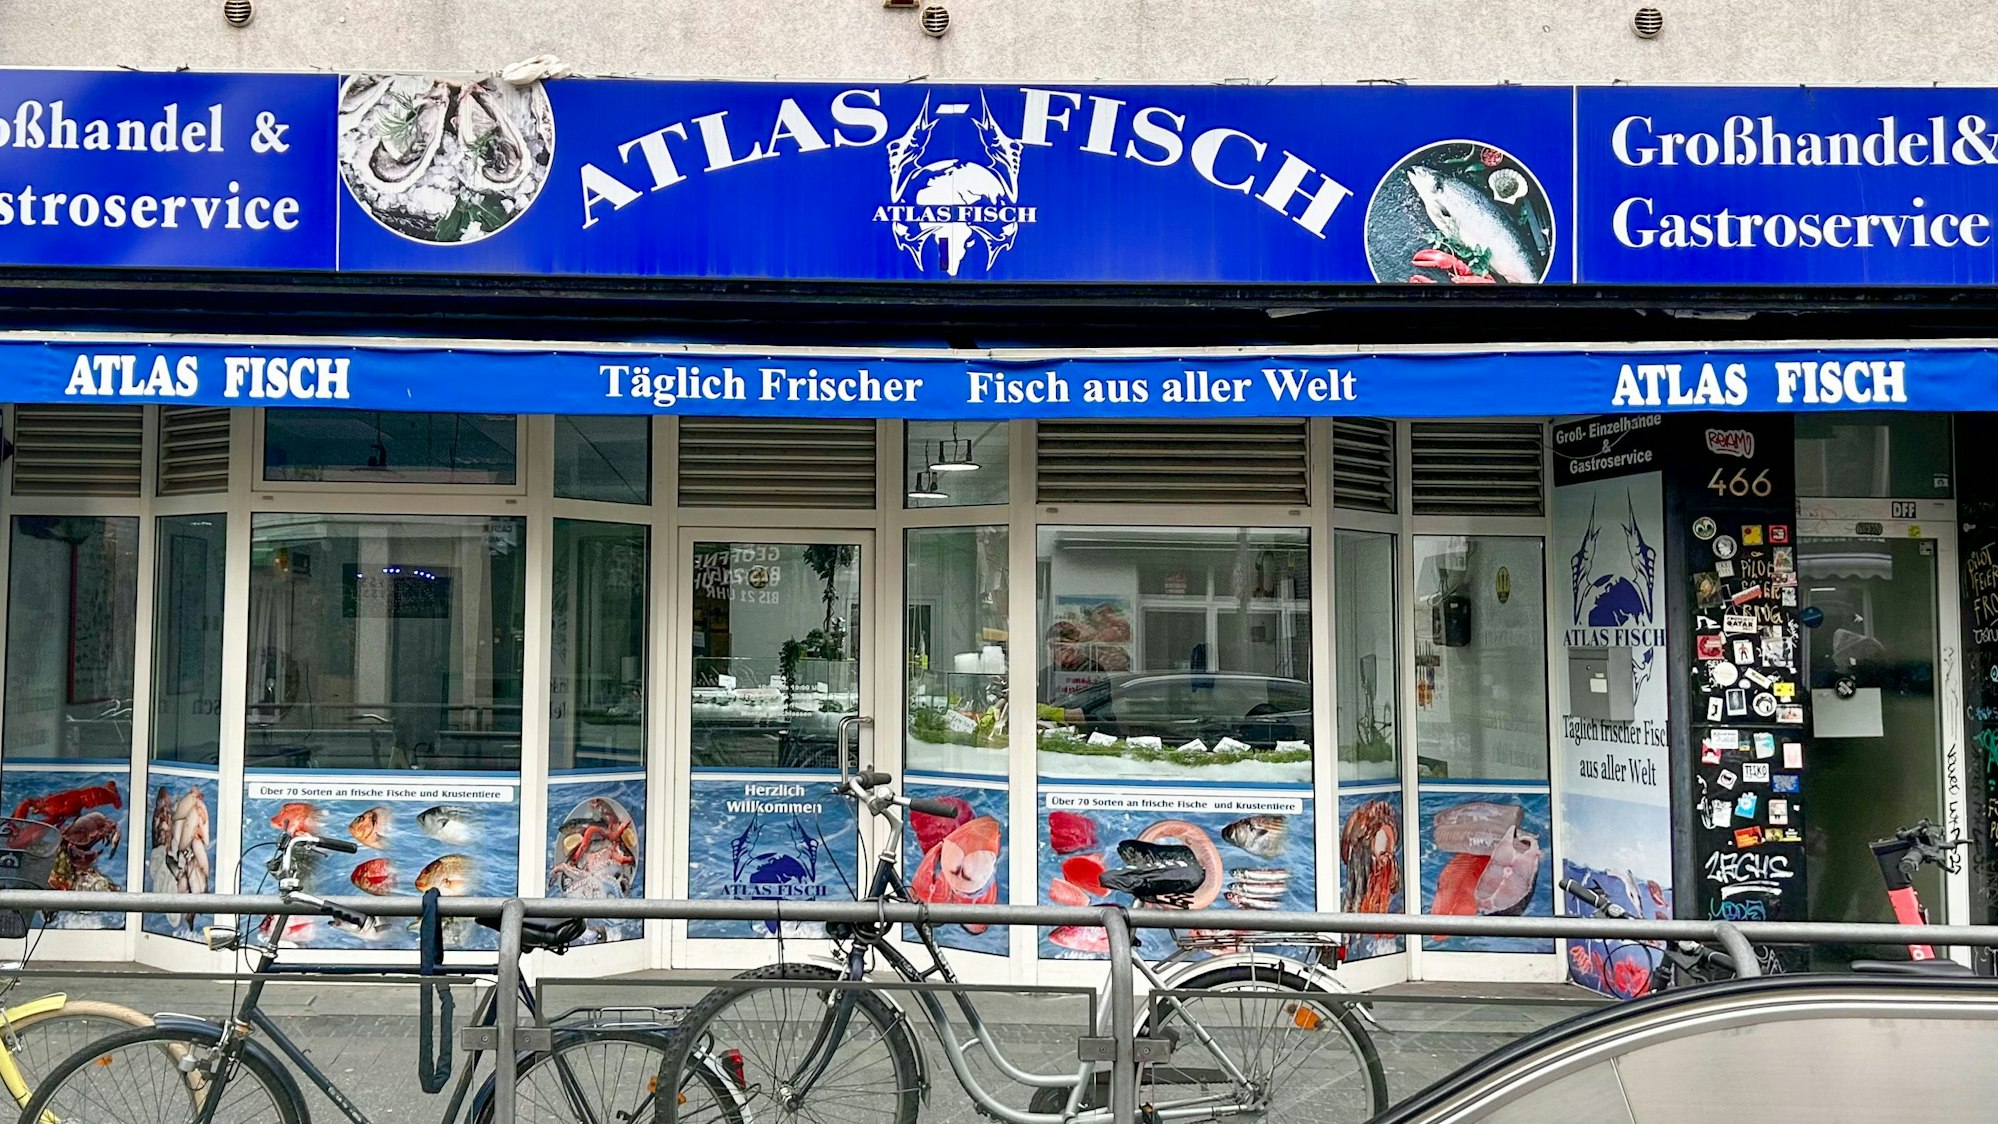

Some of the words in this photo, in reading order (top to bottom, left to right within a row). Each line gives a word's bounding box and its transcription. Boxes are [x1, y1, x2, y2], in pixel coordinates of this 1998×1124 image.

[250, 111, 290, 154] &
[581, 88, 888, 230] ATLAS
[1019, 87, 1354, 240] FISCH
[872, 206, 951, 222] ATLAS
[958, 207, 1037, 223] FISCH
[1612, 196, 1990, 248] Gastroservice
[64, 355, 198, 397] ATLAS
[223, 357, 351, 399] FISCH
[599, 365, 746, 407] Täglich
[759, 368, 923, 403] Frischer
[967, 371, 1070, 404] Fisch
[1083, 379, 1149, 404] aus
[1162, 370, 1252, 404] aller
[1261, 368, 1358, 402] Welt
[1611, 363, 1748, 406] ATLAS
[1774, 361, 1908, 404] FISCH
[1602, 439, 1612, 453] &
[1569, 449, 1653, 474] Gastroservice
[1707, 467, 1772, 497] 466
[1892, 502, 1915, 518] DFF
[1563, 628, 1609, 647] ATLAS
[1615, 628, 1666, 647] FISCH
[1563, 715, 1599, 746] Täglich
[1580, 758, 1599, 779] aus
[1601, 754, 1627, 782] aller
[1628, 757, 1657, 787] Welt
[260, 786, 284, 796] Über
[286, 788, 299, 796] 70
[301, 788, 333, 797] Sorten
[350, 788, 384, 797] frische
[386, 788, 417, 798] Fische
[420, 789, 439, 798] und
[441, 790, 501, 799] Krustentiere
[744, 784, 806, 797] Herzlich
[726, 801, 823, 814] Willkommen
[1051, 796, 1076, 806] Über
[1078, 798, 1090, 806] 70
[1092, 798, 1124, 807] Sorten
[1141, 798, 1175, 808] frische
[1177, 800, 1208, 808] Fische
[1214, 801, 1233, 809] und
[1235, 801, 1296, 811] Krustentiere
[720, 884, 772, 896] ATLAS
[778, 885, 827, 897] FISCH
